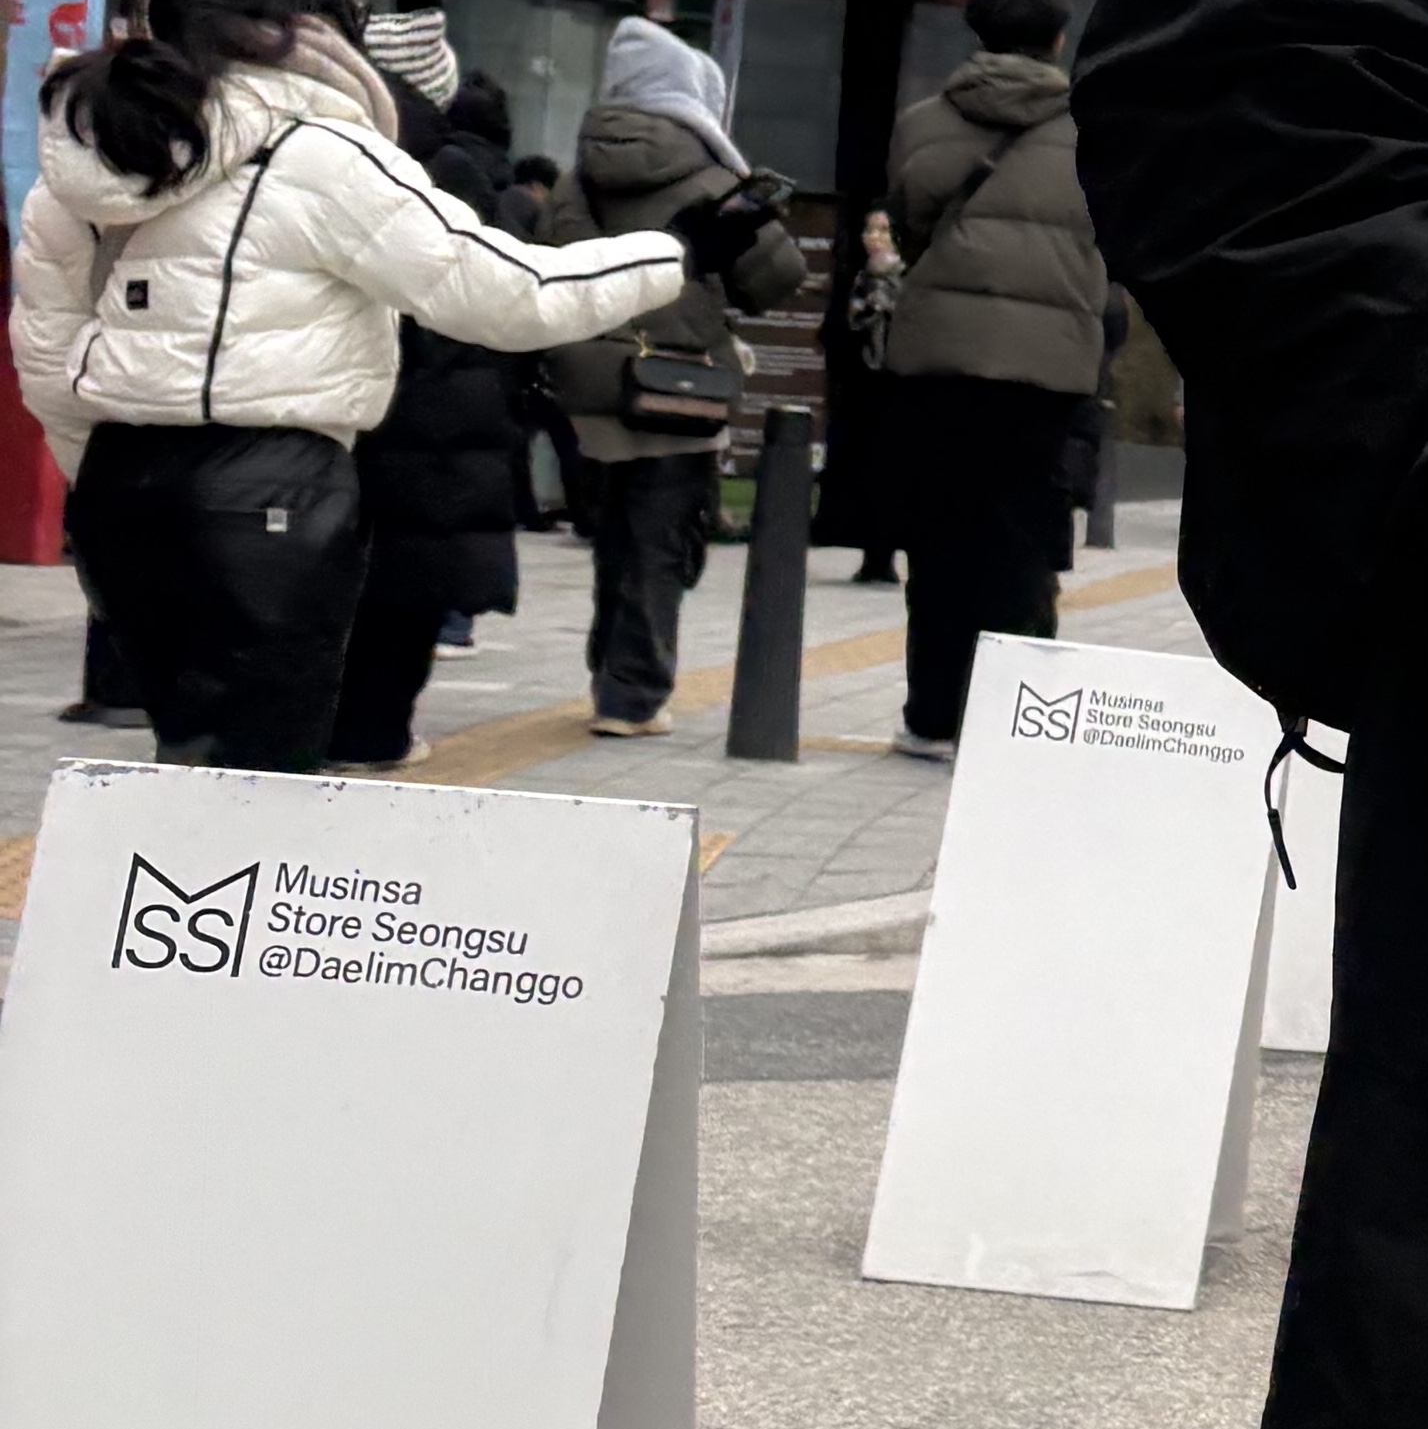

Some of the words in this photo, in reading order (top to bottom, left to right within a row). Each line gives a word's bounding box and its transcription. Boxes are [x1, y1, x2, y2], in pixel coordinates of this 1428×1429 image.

[275, 862, 423, 906] Musinsa
[267, 902, 362, 939] Store
[371, 912, 529, 959] Seongsu
[259, 944, 585, 1005] @DaelimChanggo
